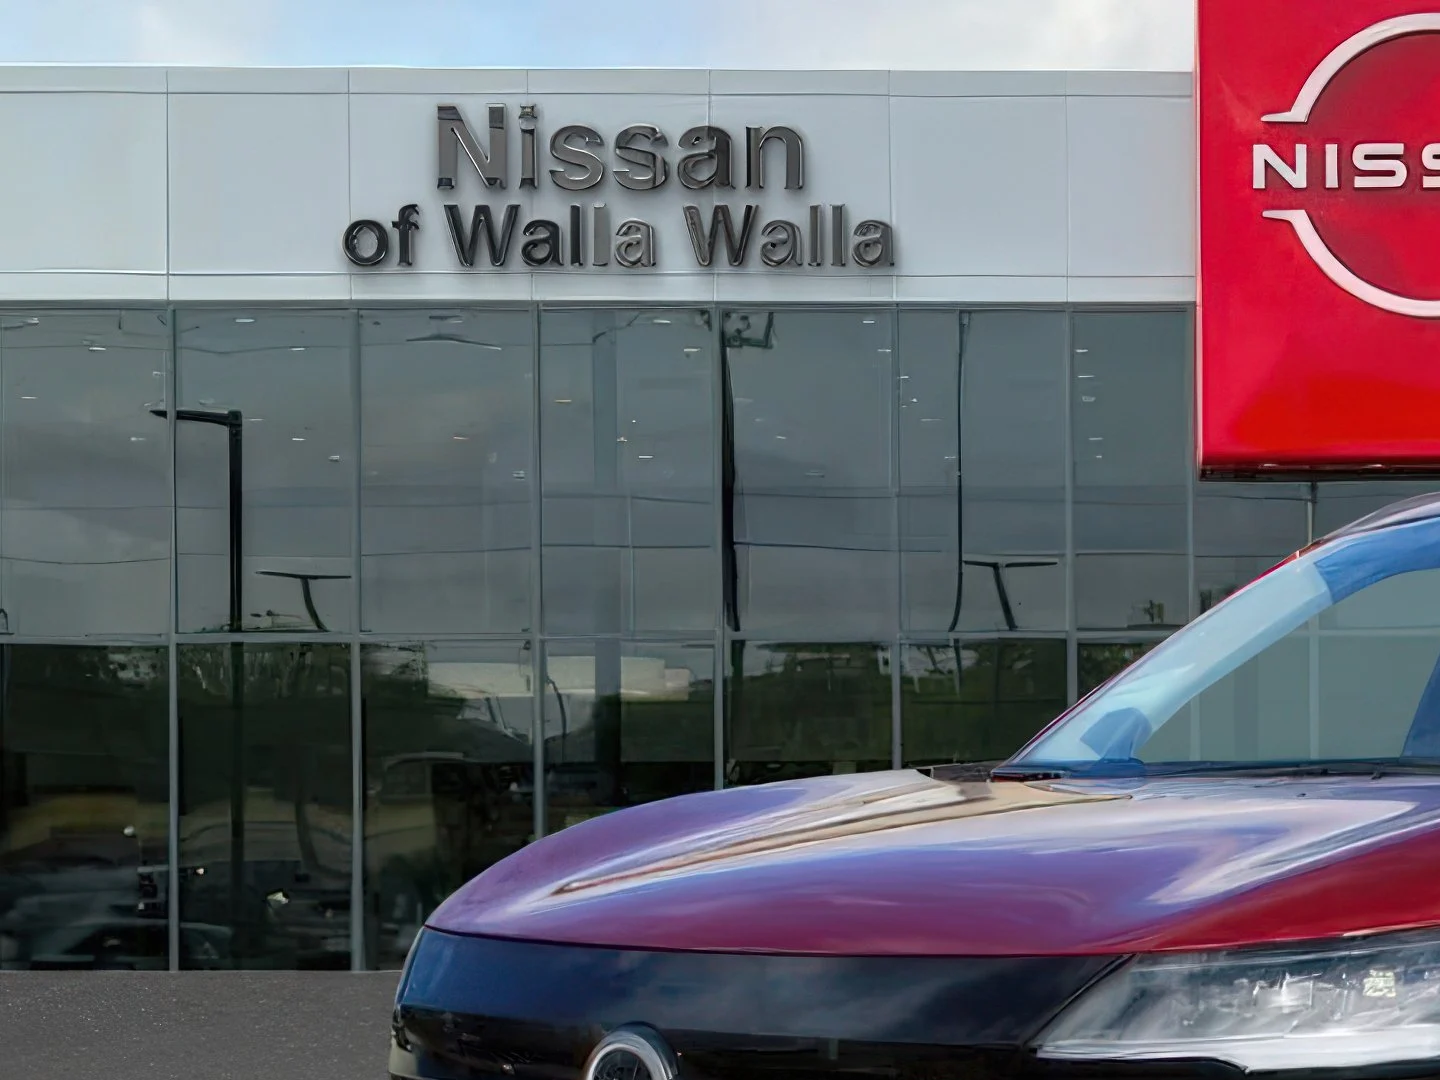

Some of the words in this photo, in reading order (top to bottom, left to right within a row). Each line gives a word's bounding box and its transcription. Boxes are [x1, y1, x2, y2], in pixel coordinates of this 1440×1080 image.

[436, 103, 803, 190] Nissan
[342, 203, 420, 267] of
[444, 203, 657, 267] Walla
[683, 203, 895, 267] Walla
